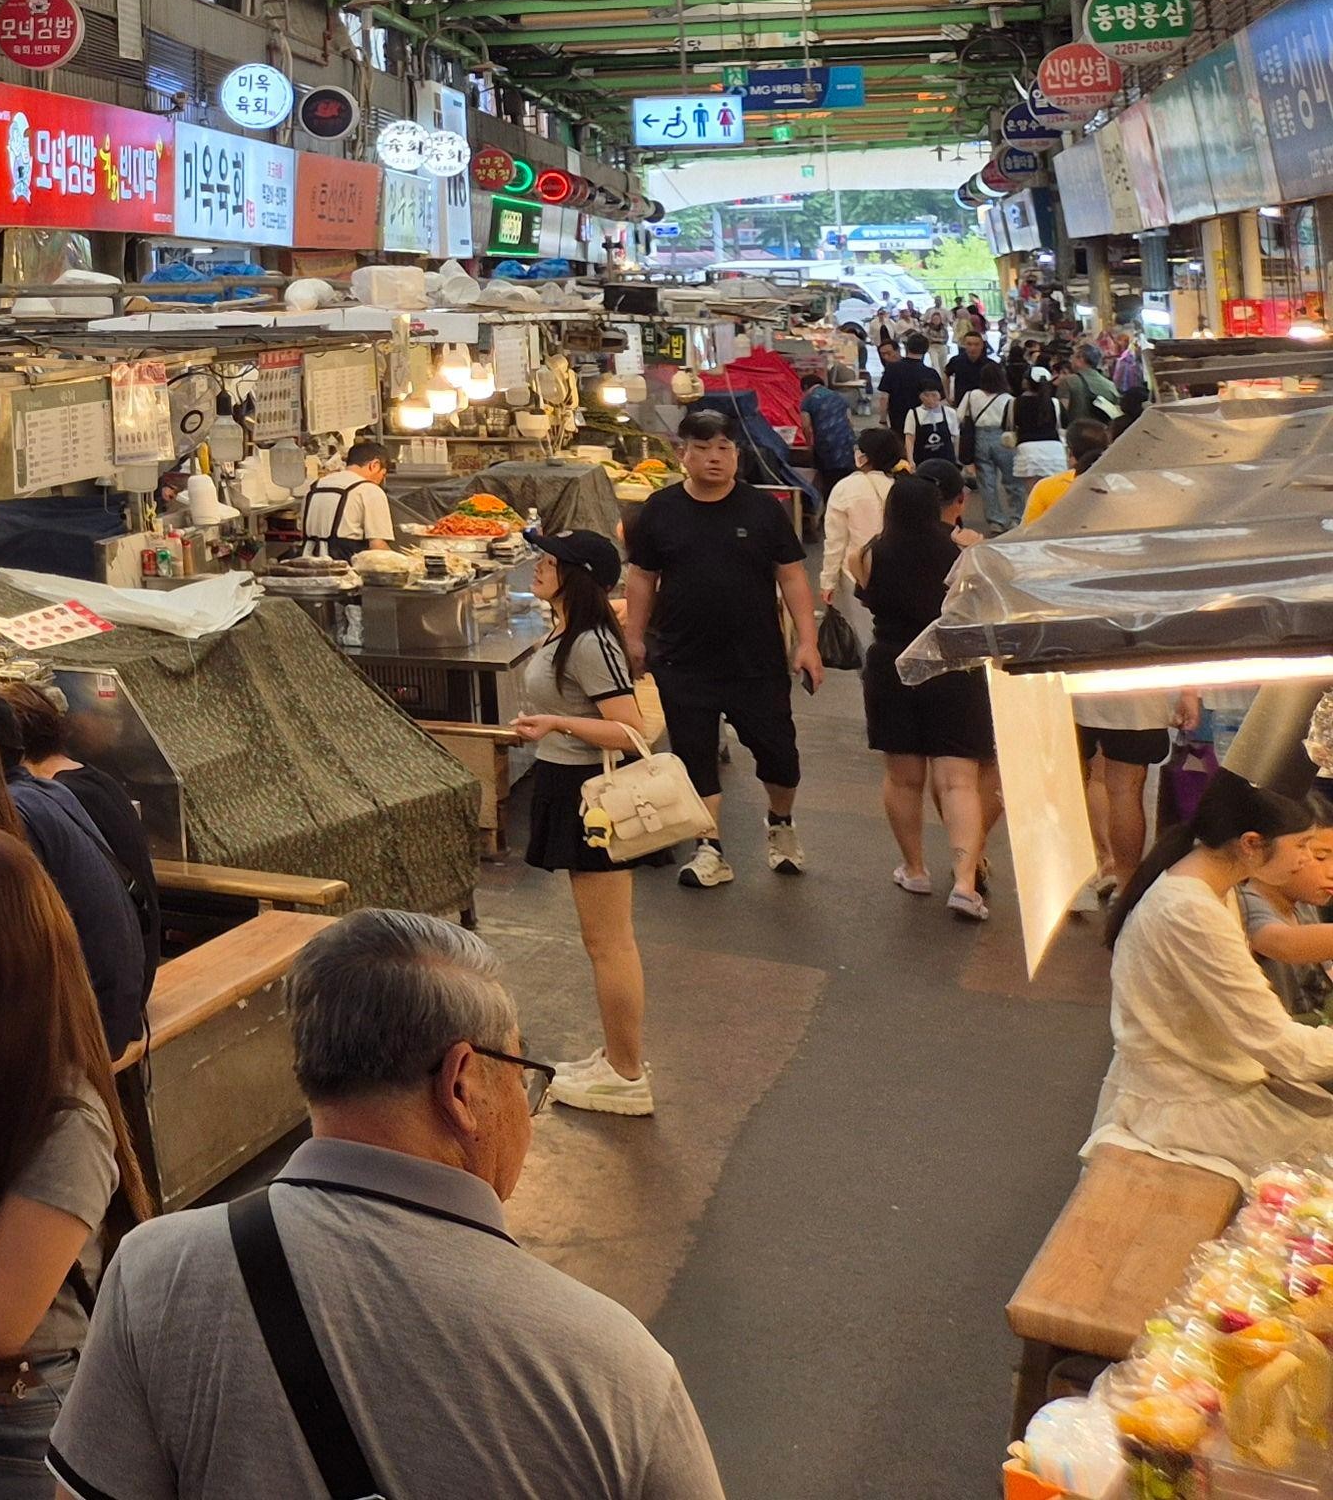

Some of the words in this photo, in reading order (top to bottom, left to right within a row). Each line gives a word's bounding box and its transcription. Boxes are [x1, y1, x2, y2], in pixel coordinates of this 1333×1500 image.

[1, 16, 74, 40] 모녀김밥
[1092, 0, 1185, 31] 동명홍삼
[1114, 40, 1174, 56] 2267-6043
[238, 74, 271, 93] 미옥
[1044, 57, 1112, 89] 신안상회
[235, 96, 268, 115] 육회
[35, 130, 97, 195] 모녀김밥
[120, 145, 157, 204] 빈대떡
[183, 141, 245, 229] 미옥육회
